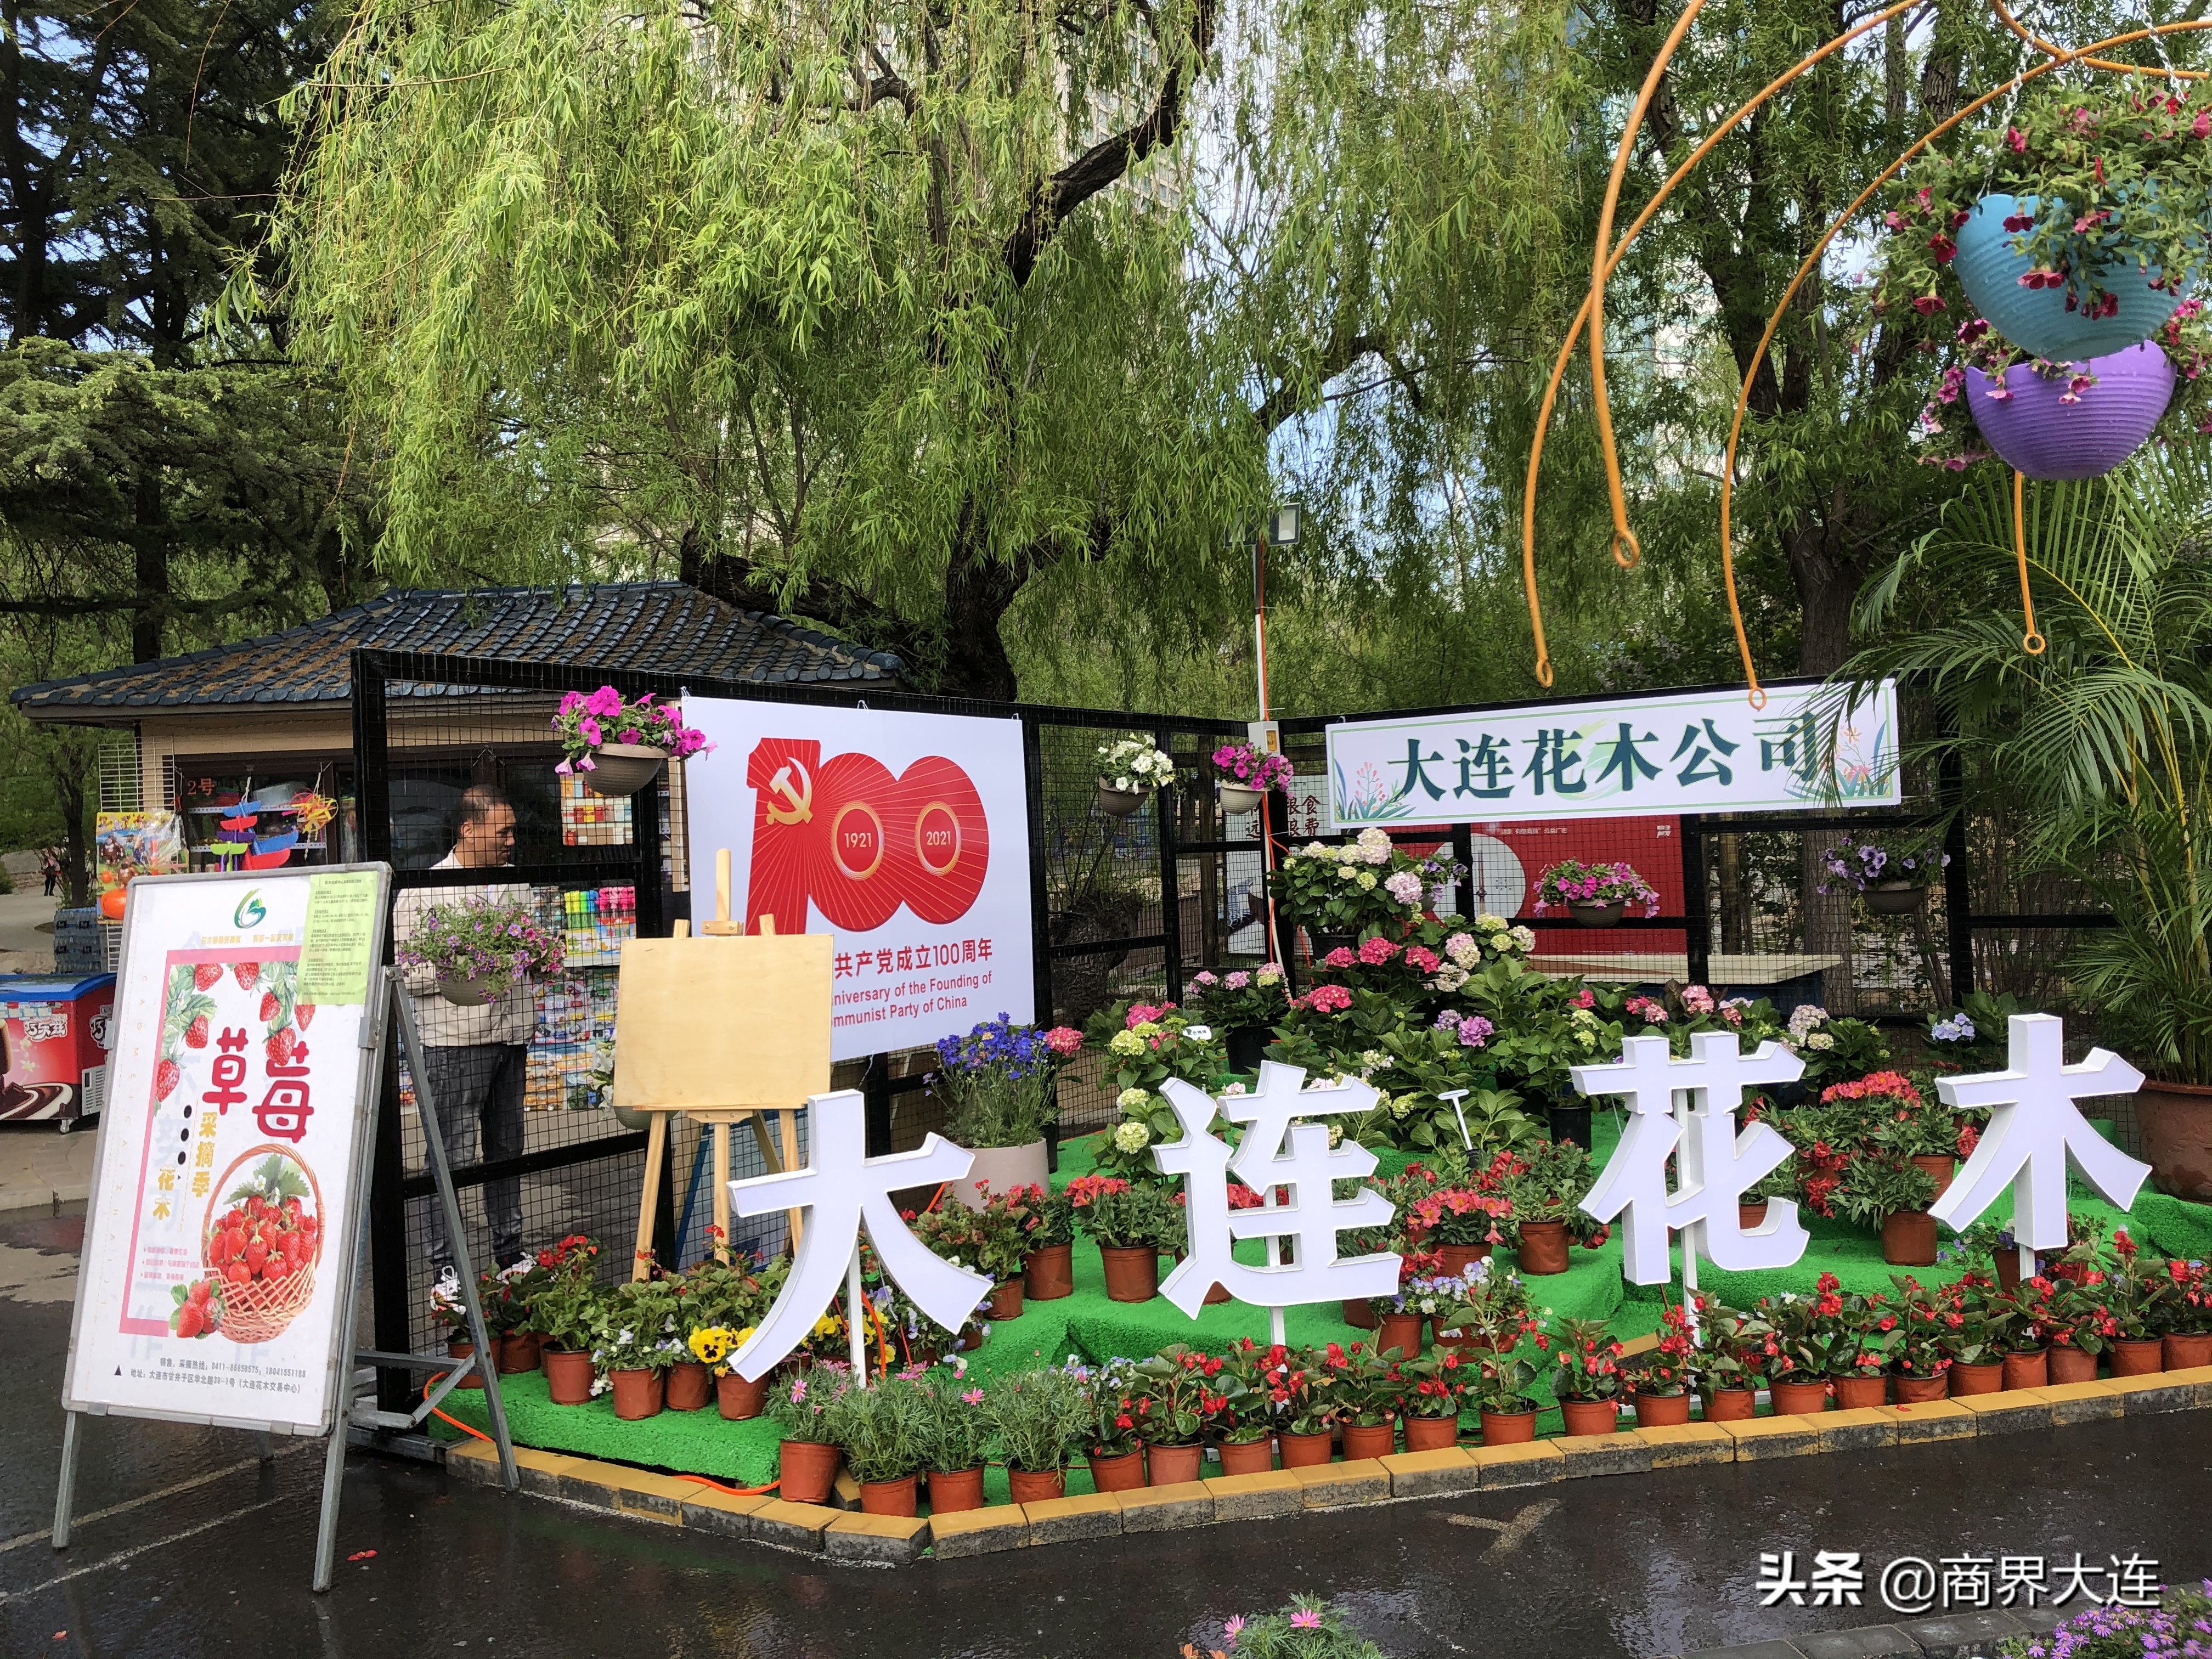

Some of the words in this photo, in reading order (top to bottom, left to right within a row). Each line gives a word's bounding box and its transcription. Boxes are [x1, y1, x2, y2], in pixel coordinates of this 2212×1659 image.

[1387, 712, 1818, 802] 大连花木公司
[188, 777, 215, 796] 2号
[844, 832, 872, 848] 1921
[926, 831, 951, 847] 2021
[834, 938, 992, 979] 共产党成立100周年
[832, 988, 890, 1006] niversary
[894, 981, 905, 997] of
[909, 980, 926, 995] the
[930, 974, 979, 992] Founding
[982, 970, 992, 984] of
[832, 1007, 885, 1027] mmunist
[890, 1003, 919, 1018] Party
[923, 998, 933, 1013] of
[937, 995, 967, 1011] China
[202, 1026, 314, 1143] 草莓
[192, 1111, 218, 1198] 采摘季
[153, 1164, 176, 1220] 花木
